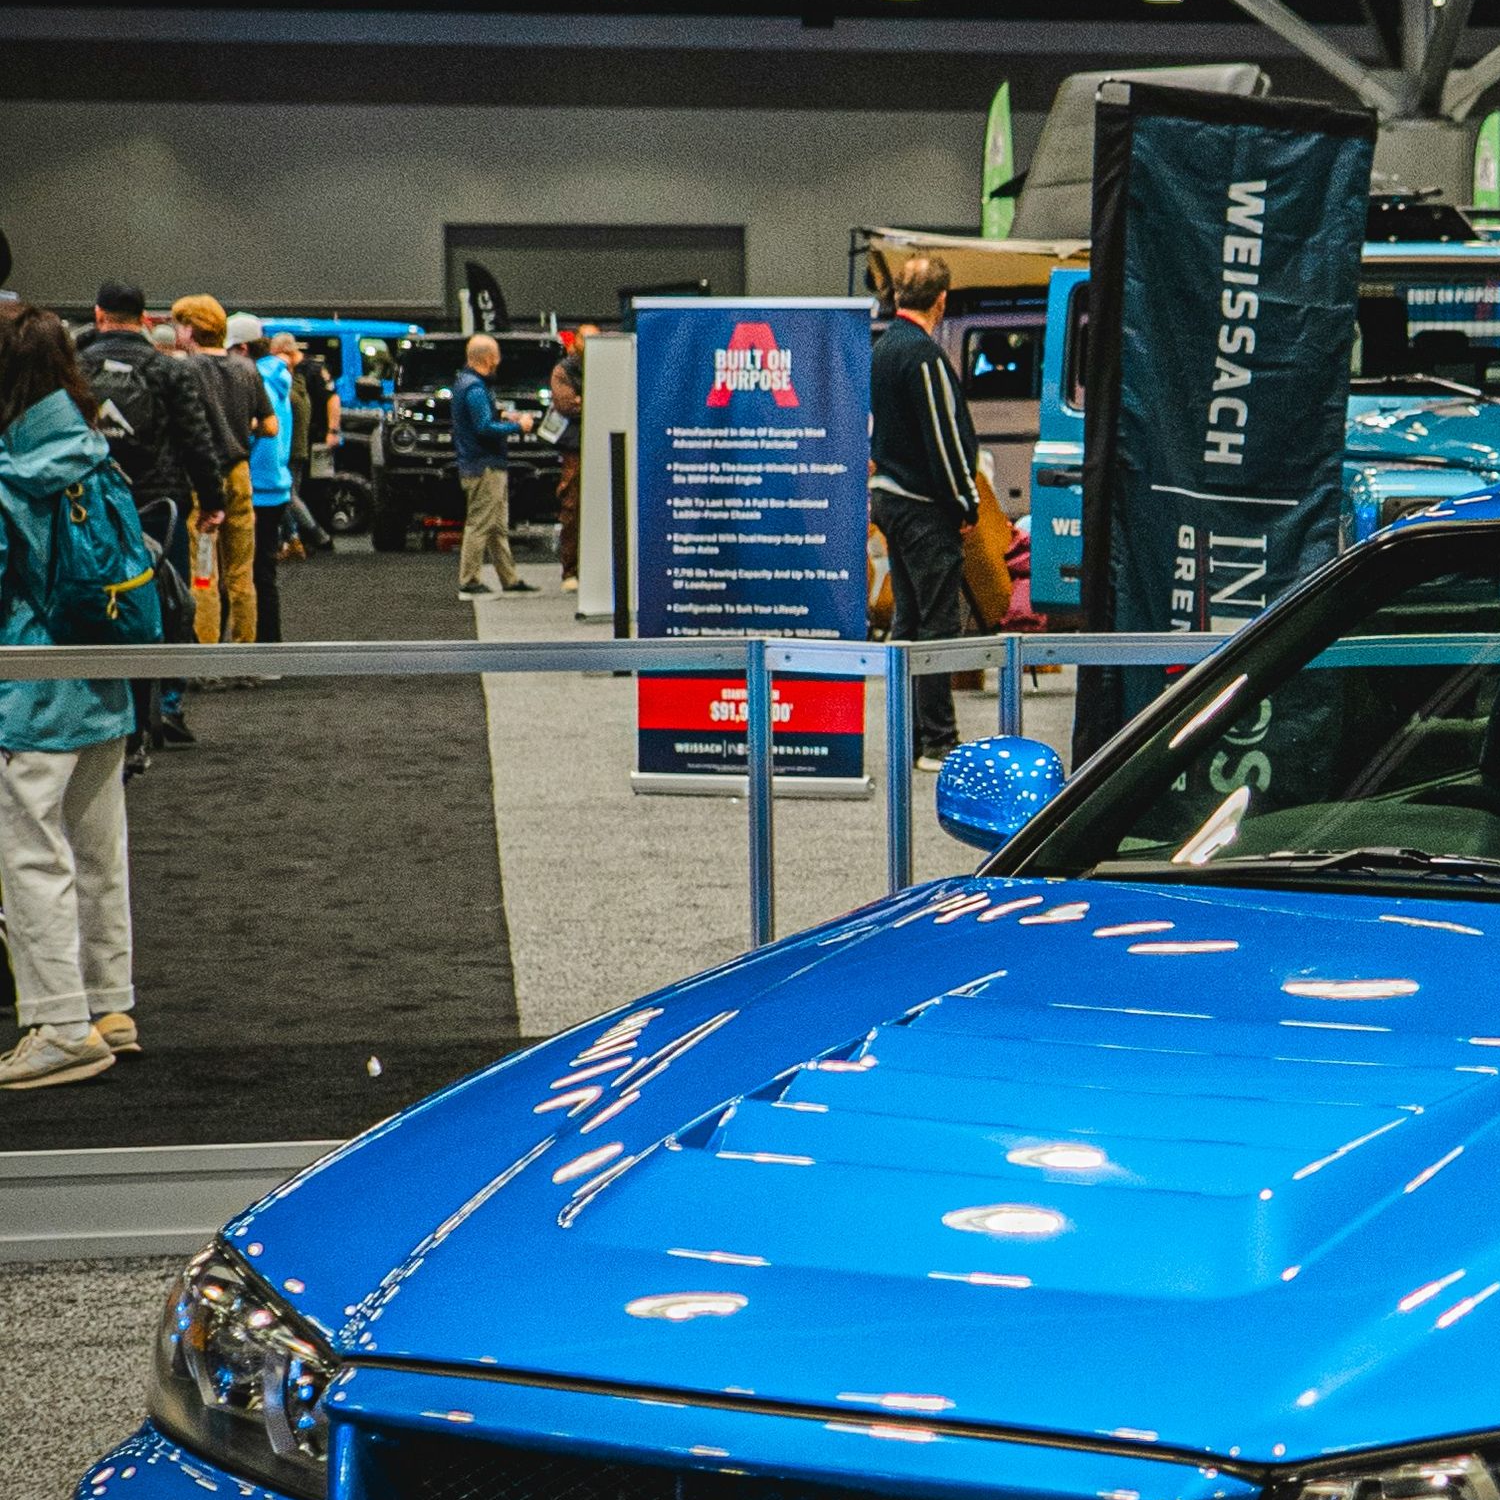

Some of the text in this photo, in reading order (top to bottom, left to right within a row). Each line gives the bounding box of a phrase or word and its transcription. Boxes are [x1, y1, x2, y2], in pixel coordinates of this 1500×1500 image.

[1203, 180, 1268, 466] WEISSACH
[714, 348, 791, 371] BUILT ON
[714, 368, 791, 391] PURPOSE
